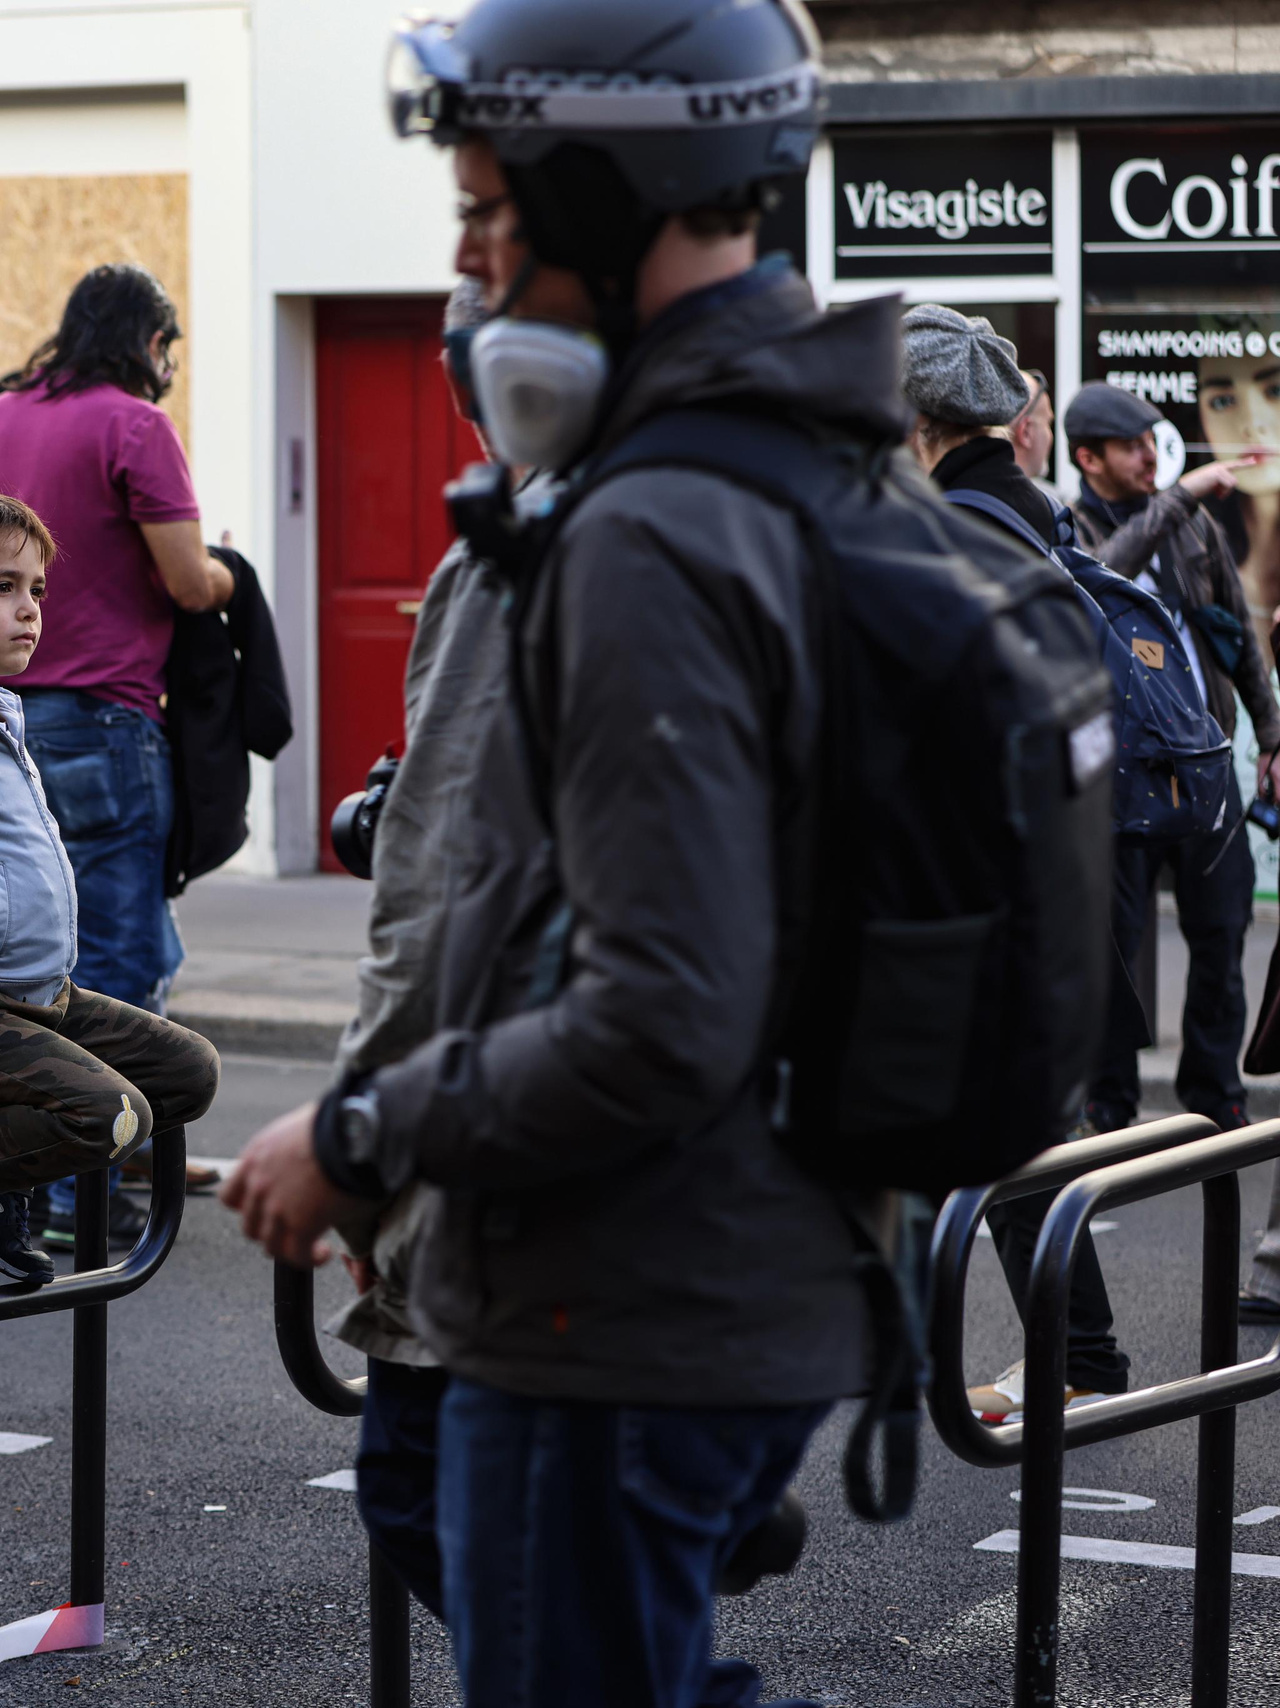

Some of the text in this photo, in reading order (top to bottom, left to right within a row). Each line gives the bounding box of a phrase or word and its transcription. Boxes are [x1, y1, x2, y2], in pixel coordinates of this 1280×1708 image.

[459, 95, 547, 121] vex
[844, 179, 1048, 240] Visagiste
[1098, 330, 1244, 358] SHAMPOOING
